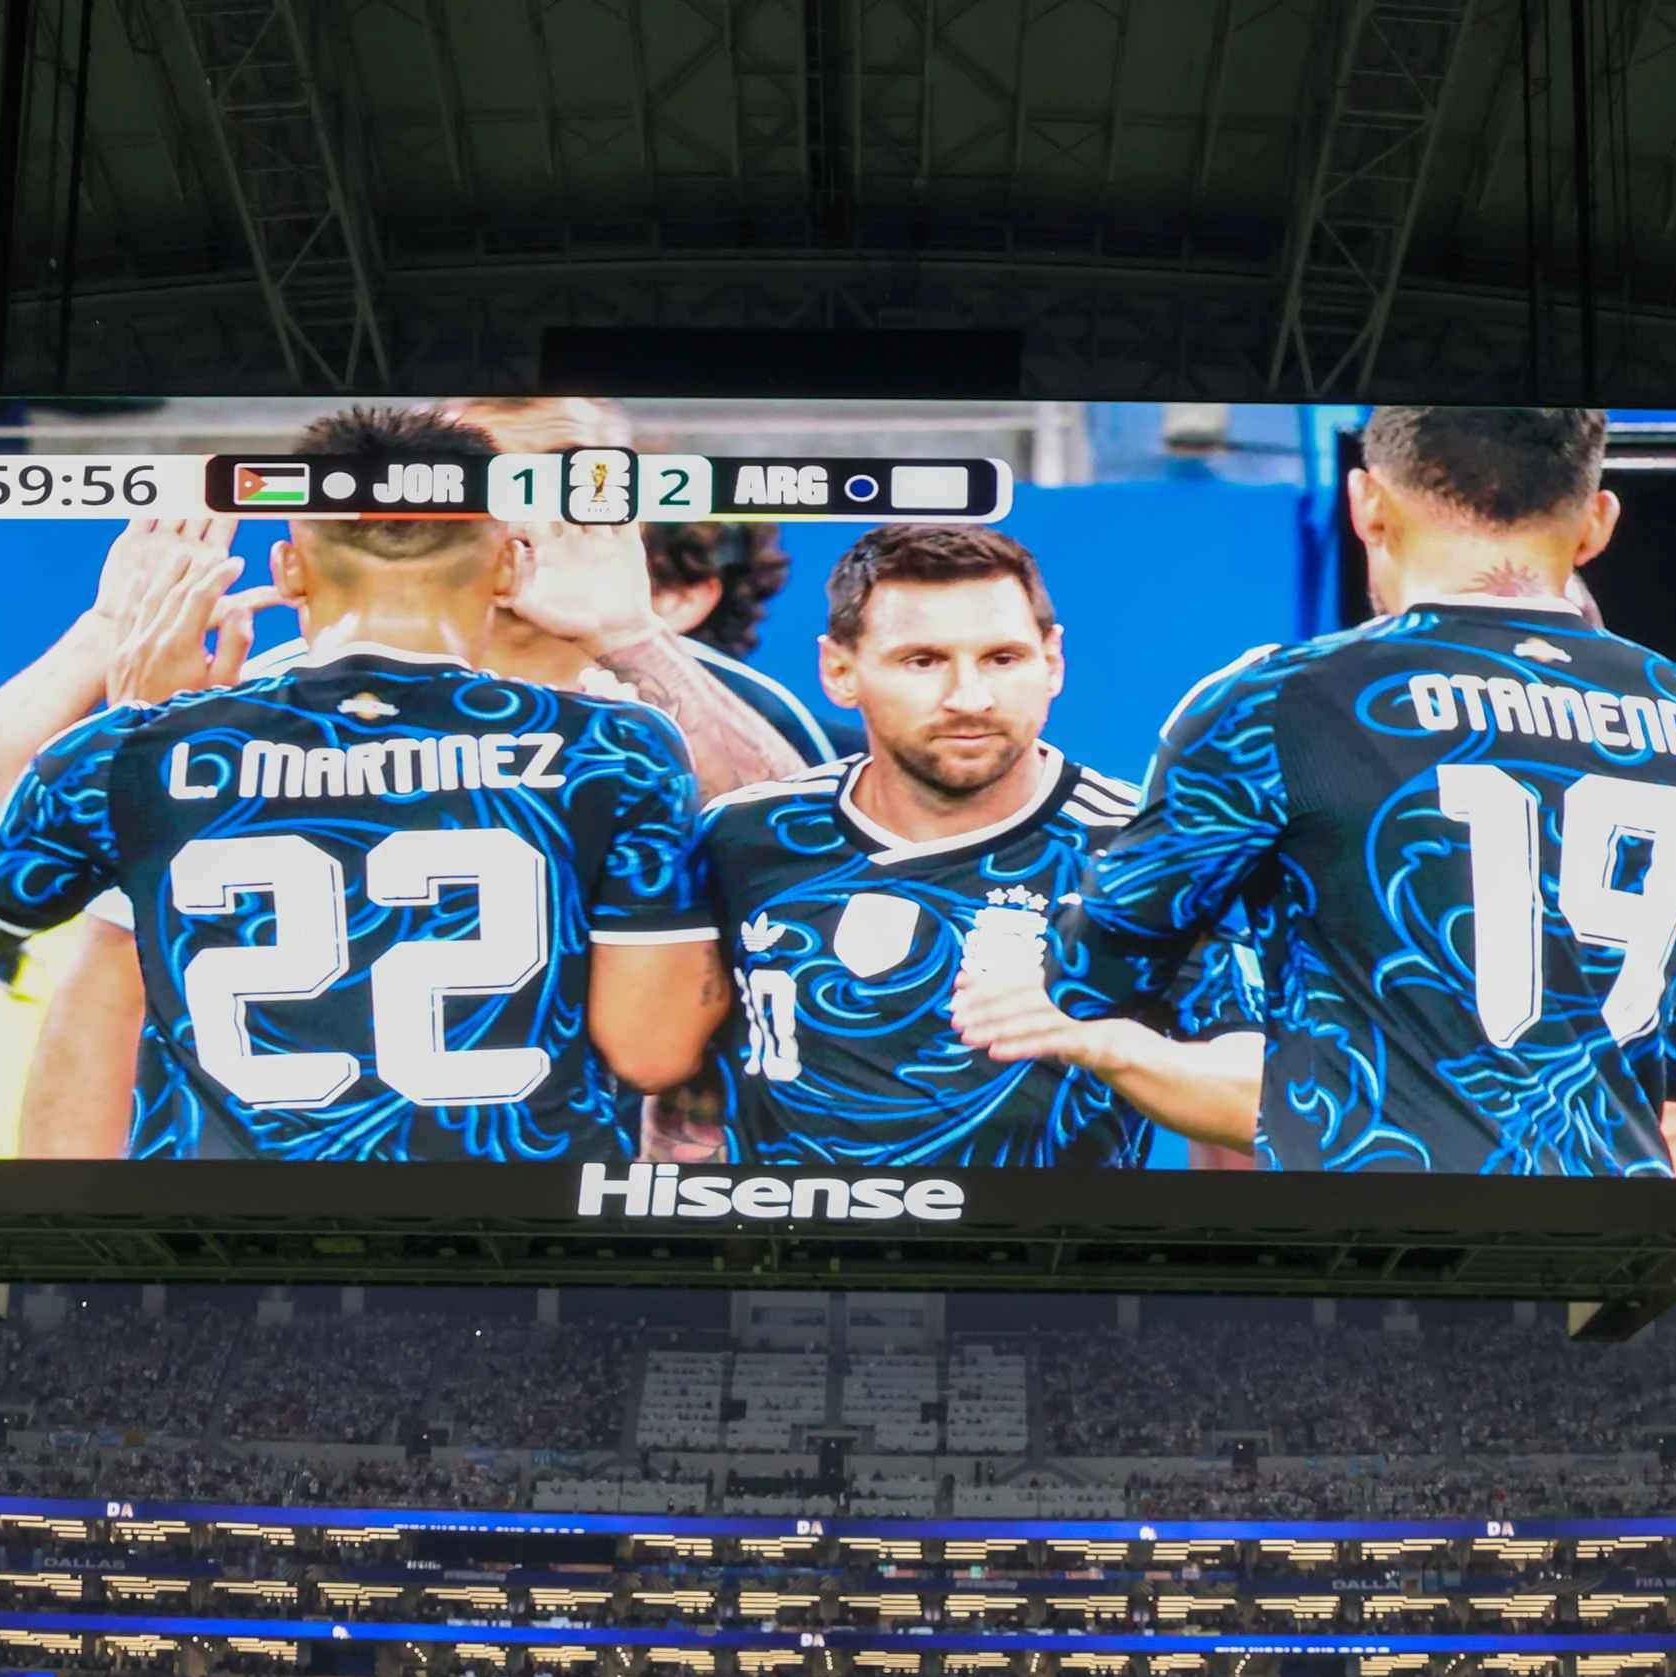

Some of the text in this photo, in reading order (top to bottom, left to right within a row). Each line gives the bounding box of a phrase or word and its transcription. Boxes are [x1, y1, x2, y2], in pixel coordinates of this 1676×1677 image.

[372, 462, 465, 504] JOR
[511, 468, 534, 505] 1
[658, 468, 691, 506] 2
[733, 464, 828, 506] ARG
[238, 732, 567, 799] MARTINEZ
[169, 828, 552, 1111] 22
[577, 1161, 964, 1221] Hisense
[1331, 1578, 1405, 1591] DALLA
